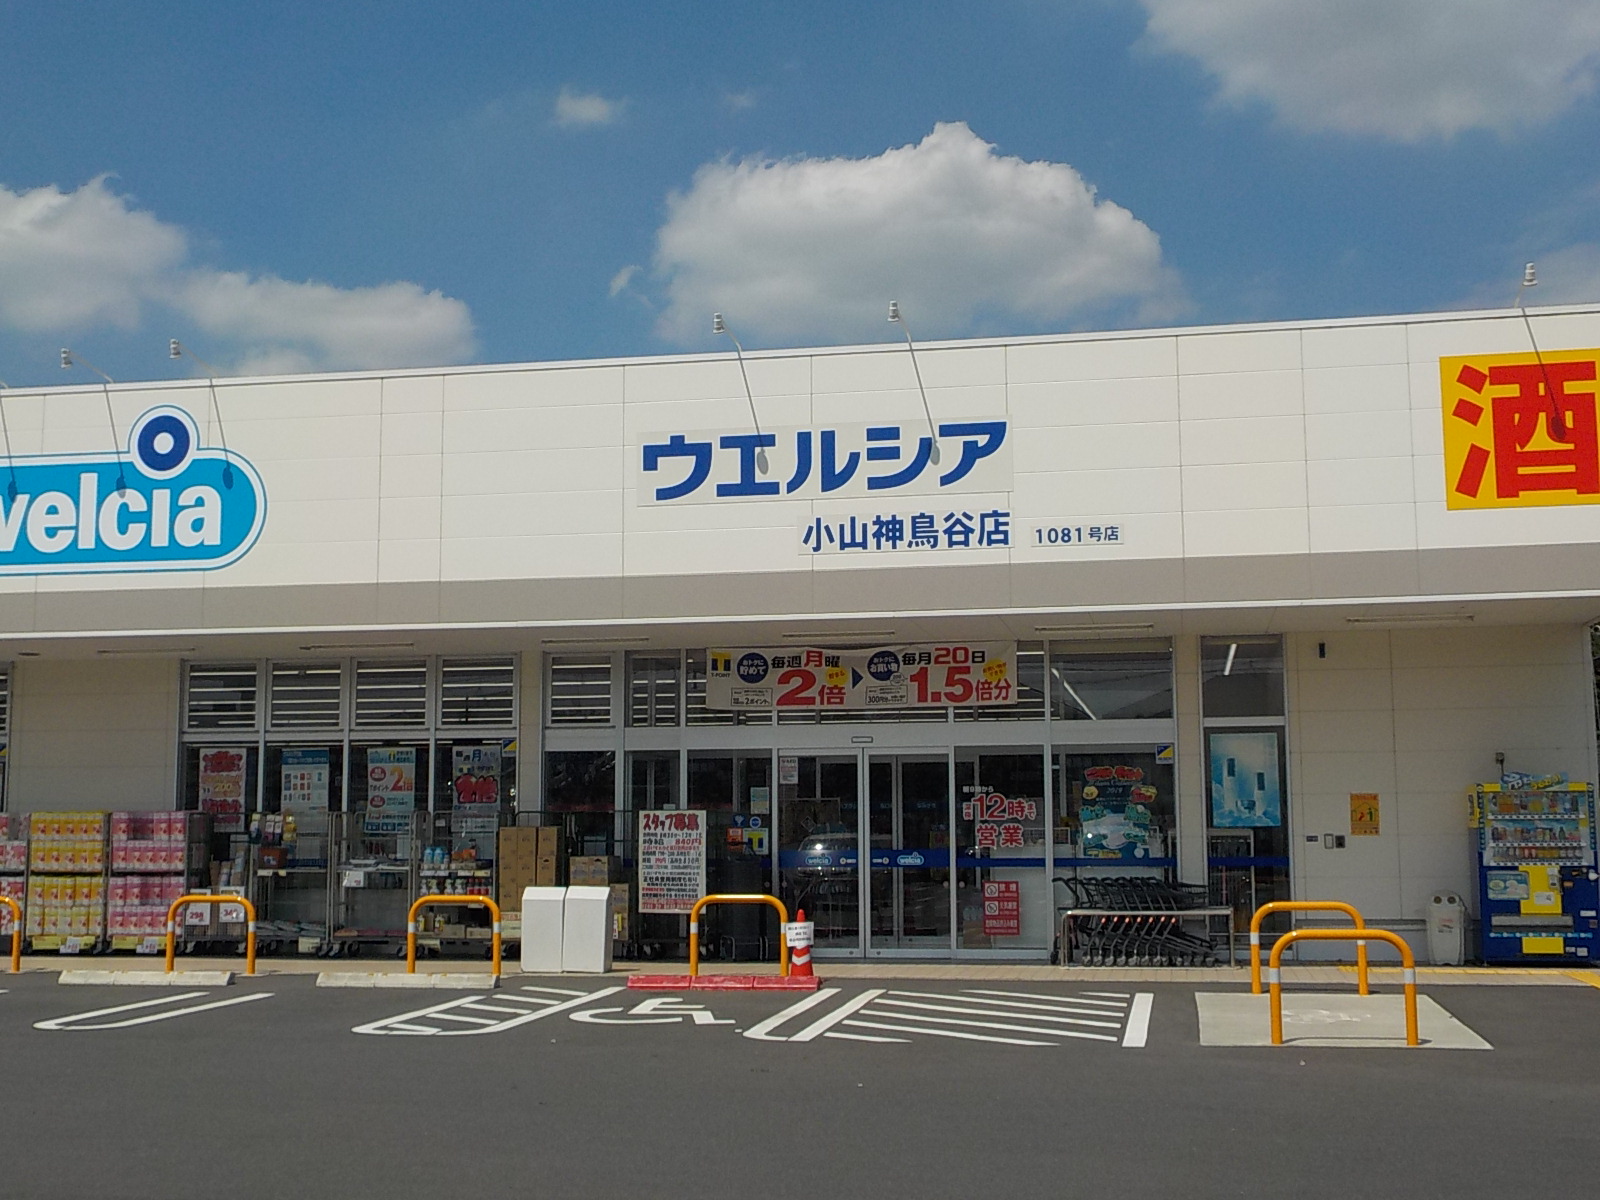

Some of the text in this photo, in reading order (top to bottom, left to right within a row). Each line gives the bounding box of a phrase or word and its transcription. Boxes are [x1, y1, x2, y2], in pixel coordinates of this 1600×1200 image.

[1452, 361, 1600, 499] 酒
[642, 421, 1007, 501] ウエルシア
[803, 510, 1011, 552] 小山神鳥谷店
[1035, 525, 1119, 545] 1081号店
[771, 650, 840, 668] 毎週月曜
[902, 647, 985, 665] 毎月20日
[977, 825, 1023, 847] 営業
